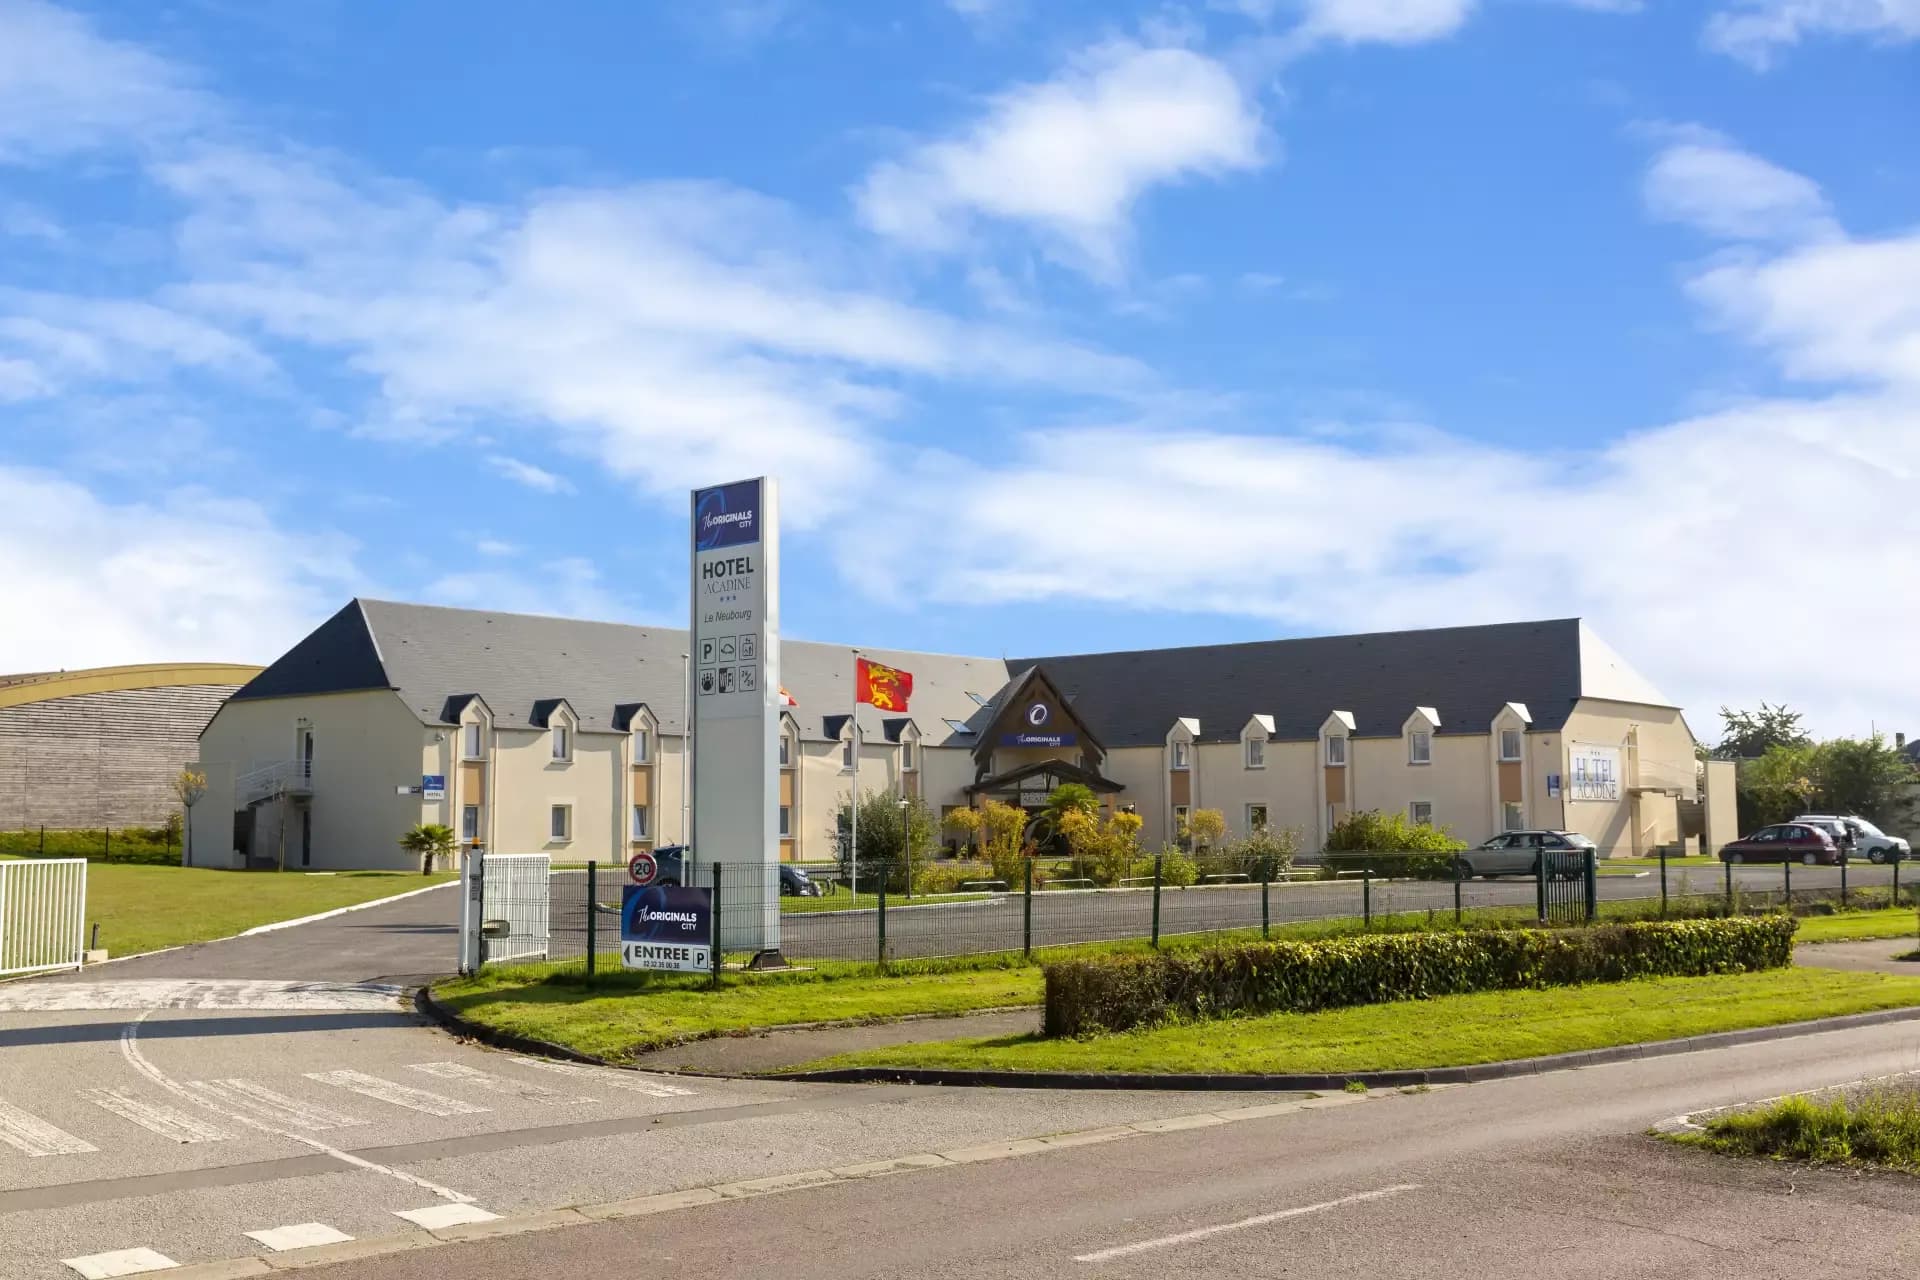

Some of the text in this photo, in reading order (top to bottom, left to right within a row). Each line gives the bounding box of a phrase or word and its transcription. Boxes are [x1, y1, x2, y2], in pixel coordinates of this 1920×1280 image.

[712, 510, 752, 525] ORIGINALS
[739, 519, 752, 528] CITY
[702, 557, 754, 580] HOTEL
[704, 577, 751, 595] ACADINE
[704, 609, 752, 623] Le Neubourg
[703, 643, 712, 660] P
[1577, 782, 1616, 799] ACADINE
[634, 863, 650, 875] 20
[650, 911, 697, 922] ORIGINALS
[681, 923, 697, 931] CITY
[634, 945, 705, 965] ENTREE P
